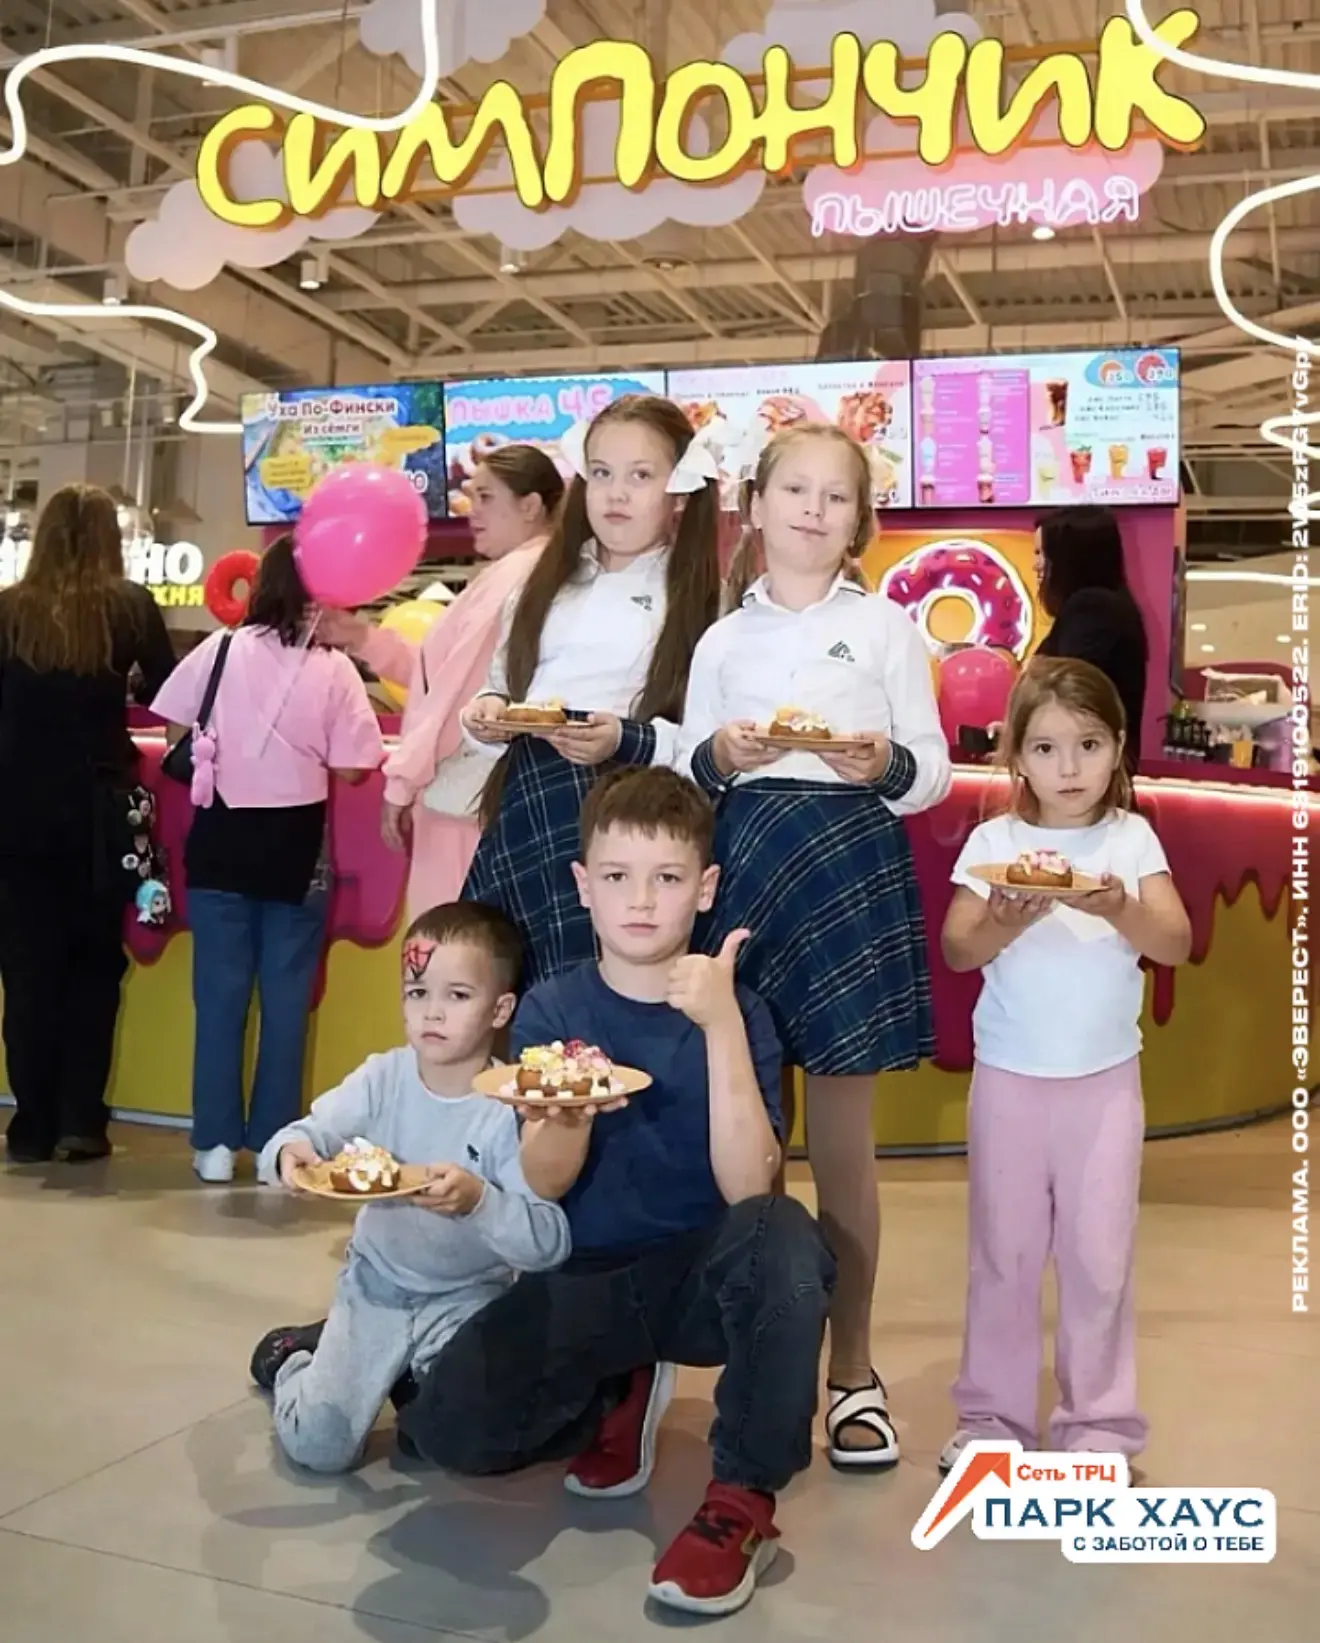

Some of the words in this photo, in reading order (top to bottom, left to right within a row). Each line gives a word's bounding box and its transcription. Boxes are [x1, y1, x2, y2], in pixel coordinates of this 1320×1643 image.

[197, 8, 1205, 226] СИМПОНЧИК
[811, 175, 1139, 237] ПЫШЕЧНАЯ
[267, 401, 298, 417] Уха
[302, 400, 397, 416] По-Фински
[452, 396, 551, 421] ПЫШКА
[303, 424, 318, 434] Из
